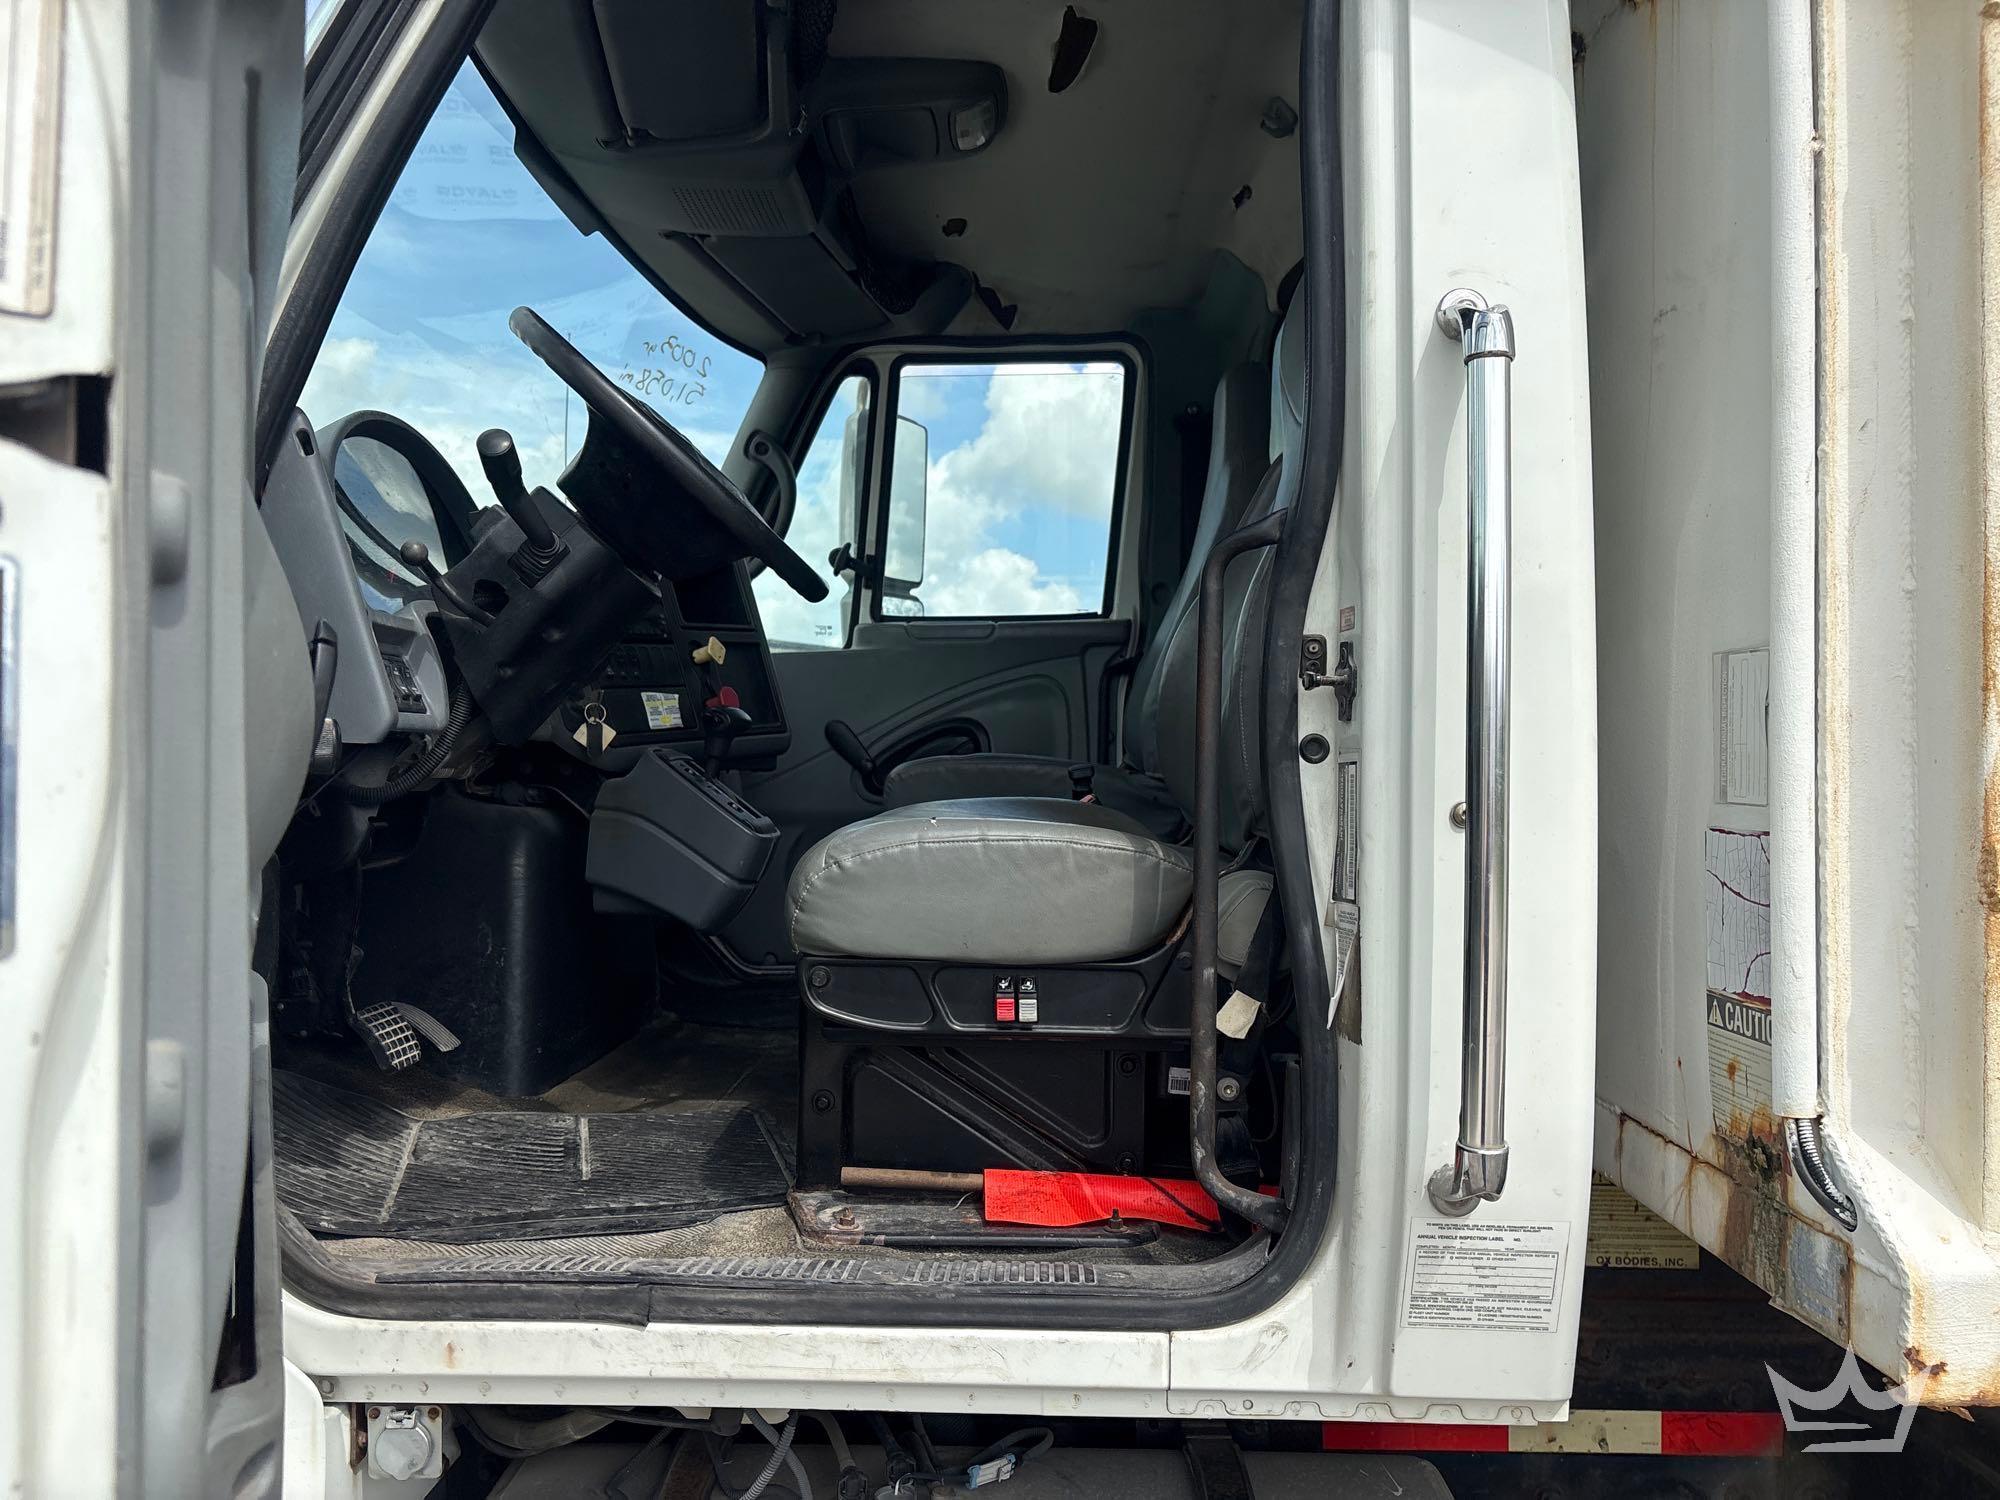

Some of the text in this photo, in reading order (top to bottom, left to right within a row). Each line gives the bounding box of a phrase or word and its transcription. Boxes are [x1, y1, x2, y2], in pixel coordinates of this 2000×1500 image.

[1596, 1256, 1687, 1267] OX BODIES, INC.
